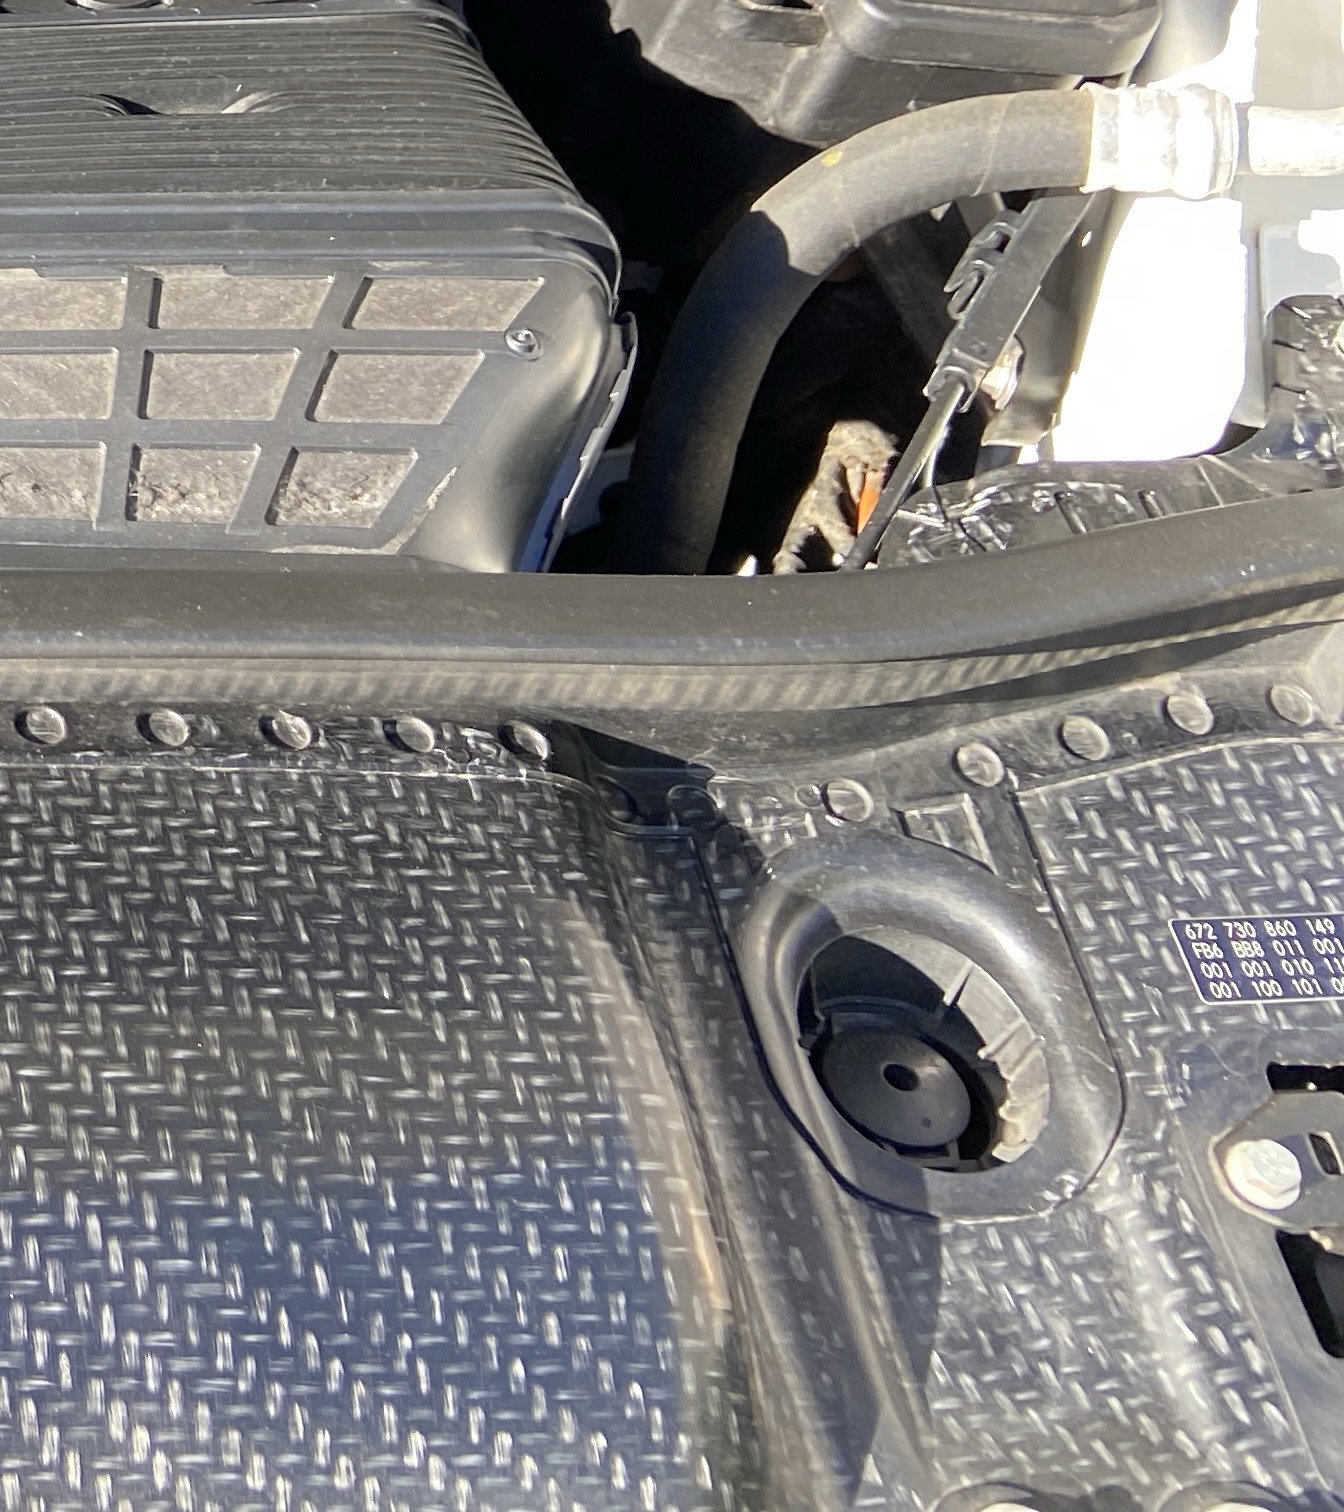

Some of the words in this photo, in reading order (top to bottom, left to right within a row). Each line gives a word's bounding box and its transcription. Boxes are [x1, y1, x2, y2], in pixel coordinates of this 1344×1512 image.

[1185, 922, 1217, 940] 672
[1222, 921, 1257, 939] 730
[1263, 919, 1298, 937] 860
[1305, 918, 1335, 936] 149
[1191, 941, 1224, 959] FB6
[1271, 939, 1306, 956] 011
[1200, 961, 1233, 979] 001
[1241, 960, 1274, 978] 001
[1281, 958, 1315, 976] 010
[1209, 981, 1242, 999] 001
[1251, 979, 1284, 997] 100
[1291, 977, 1324, 995] 101
